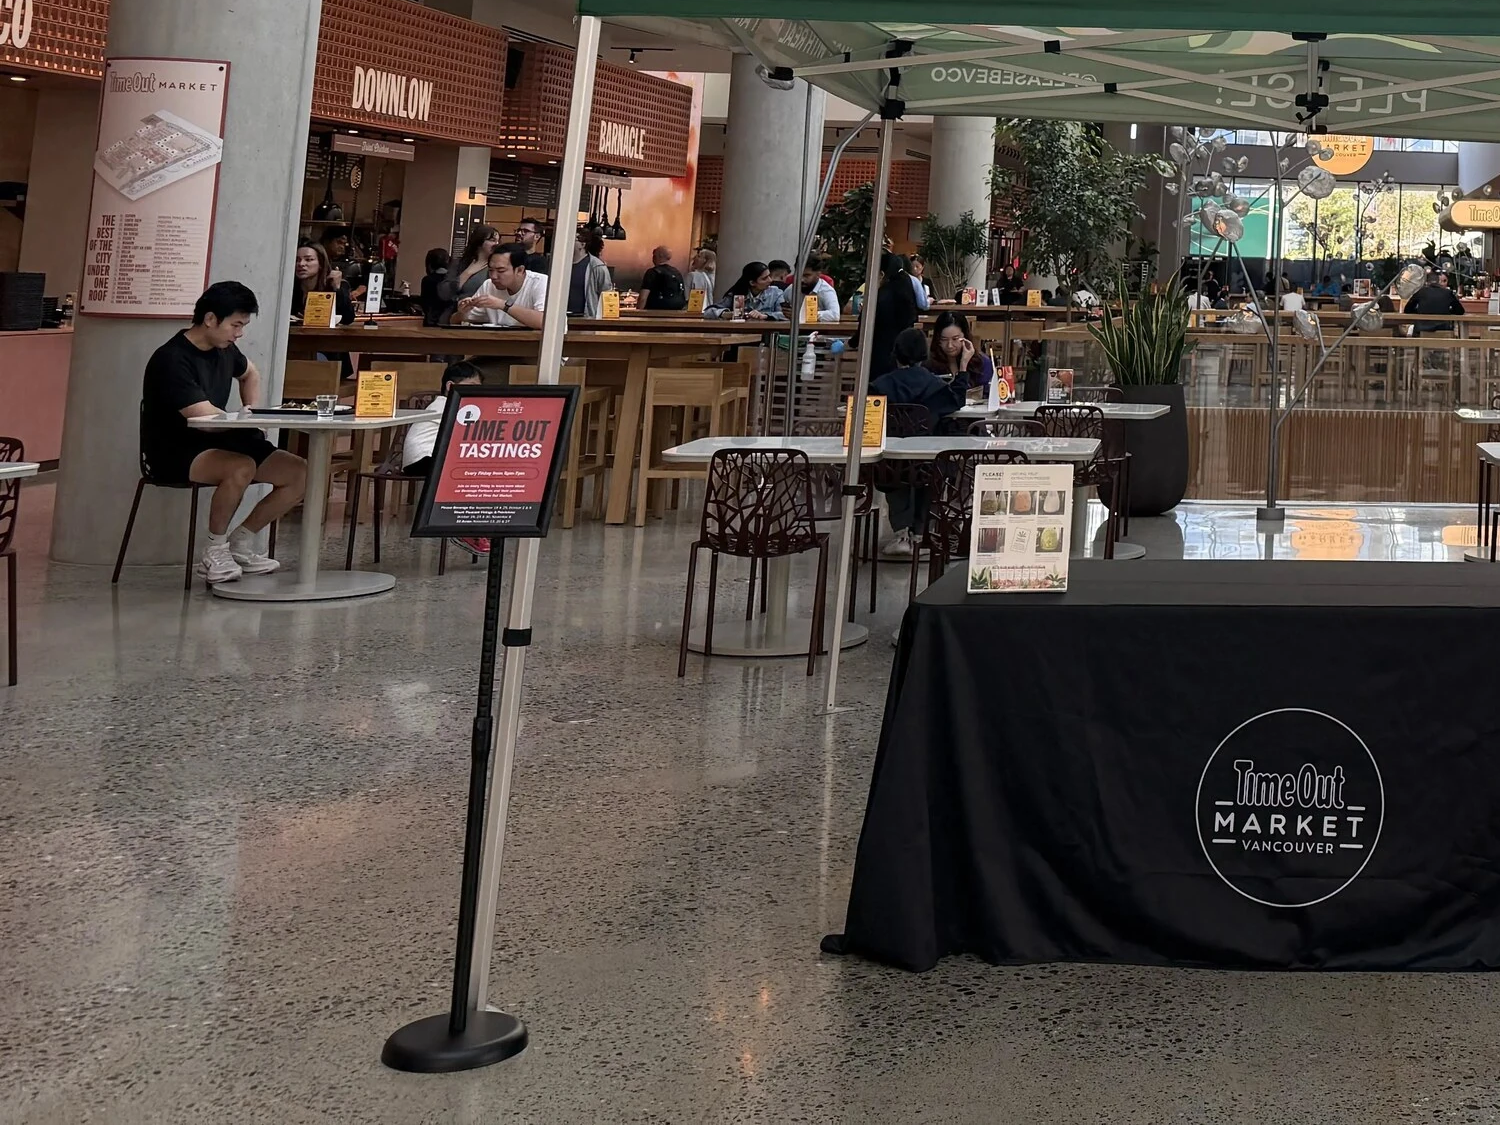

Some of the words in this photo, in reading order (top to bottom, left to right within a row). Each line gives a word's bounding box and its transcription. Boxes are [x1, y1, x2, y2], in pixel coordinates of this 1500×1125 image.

[110, 72, 133, 93] Time
[132, 72, 156, 93] Out
[159, 81, 218, 92] MARKET
[352, 66, 433, 122] DOWNLOW
[599, 120, 646, 160] BARNACLE
[1468, 204, 1492, 222] Time
[101, 215, 116, 227] THE
[96, 227, 115, 239] BEST
[89, 240, 100, 252] OF
[99, 240, 114, 252] THE
[95, 252, 112, 264] CITY
[87, 264, 111, 277] UNDER
[94, 277, 109, 289] ONE
[88, 290, 109, 302] ROOF
[462, 420, 508, 441] TIME
[512, 420, 551, 441] OUT
[459, 443, 543, 459] TASTINGS
[1234, 760, 1296, 807] Time
[1297, 763, 1345, 809] Out
[1214, 812, 1364, 838] MARKET
[1242, 839, 1334, 854] VANCOUVER
